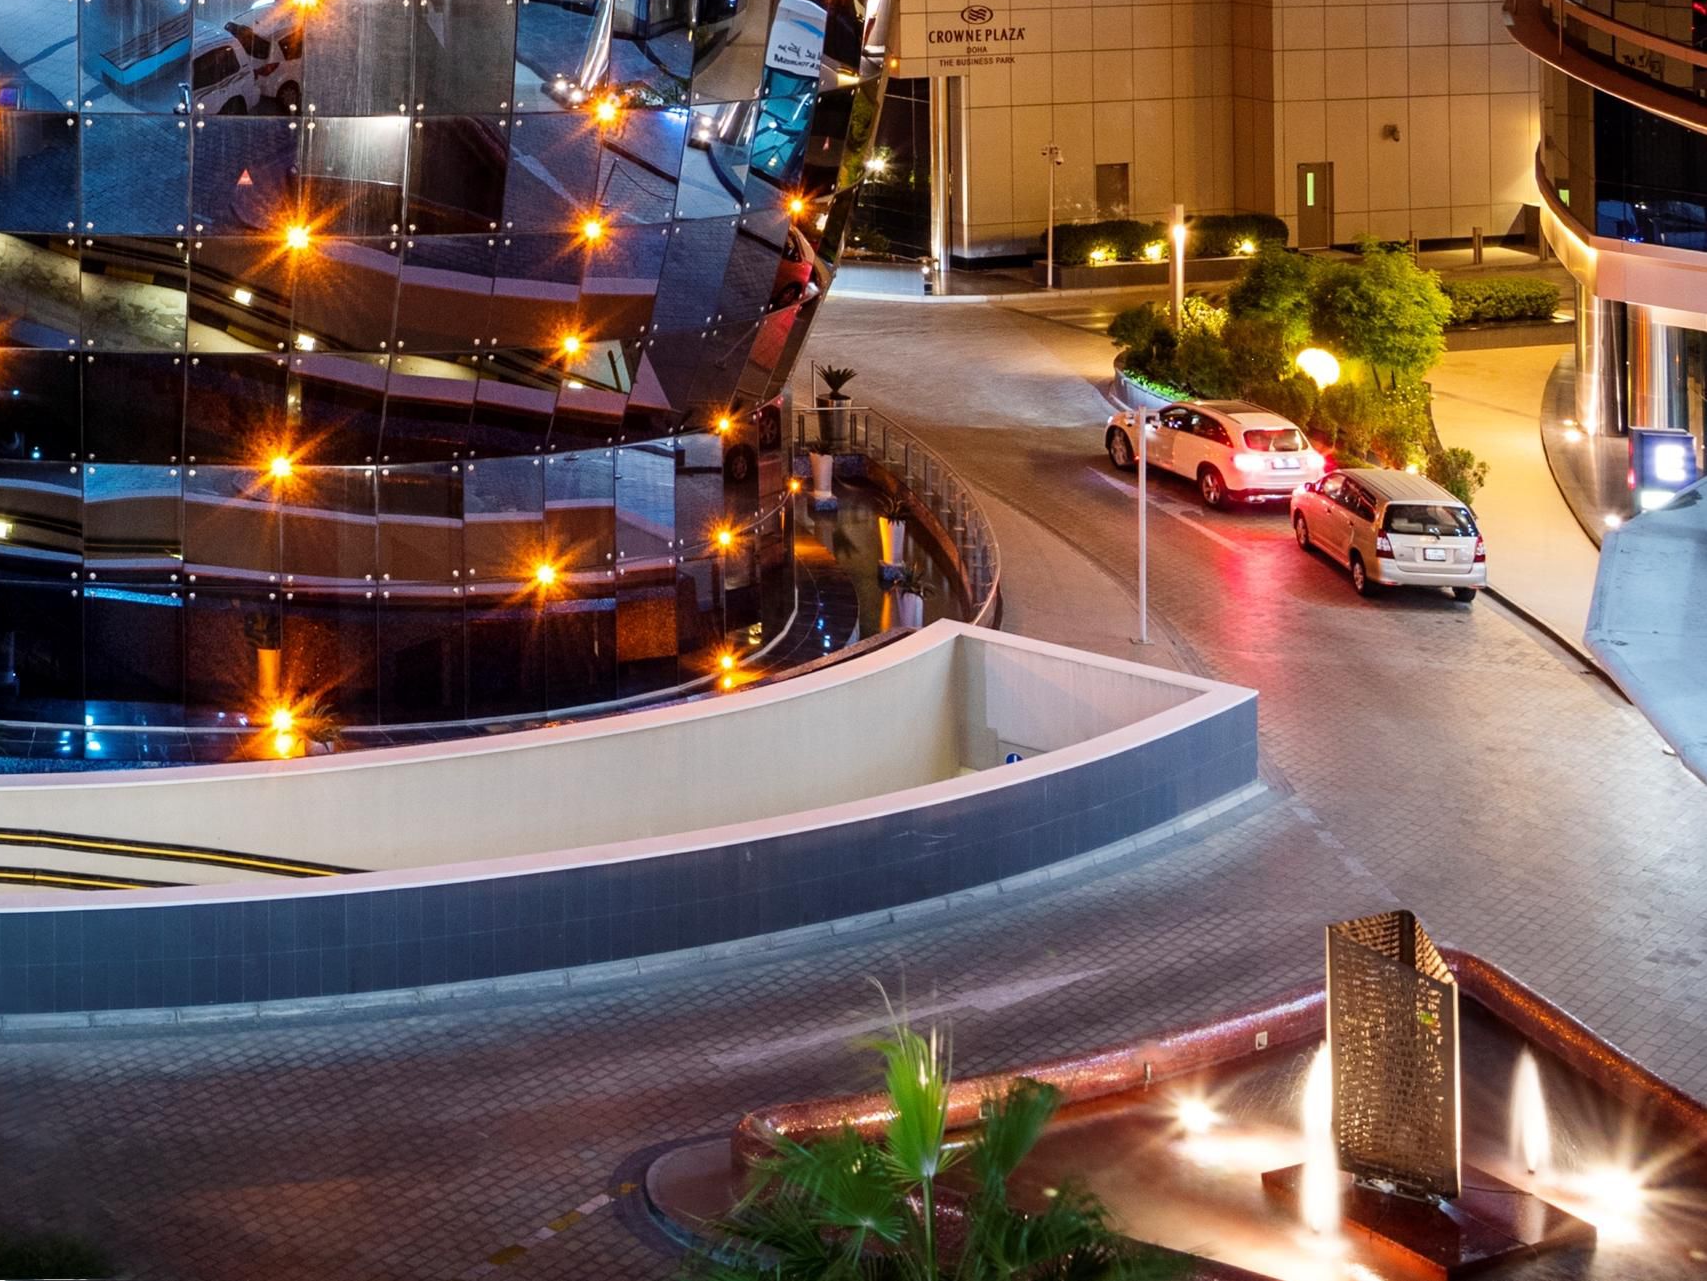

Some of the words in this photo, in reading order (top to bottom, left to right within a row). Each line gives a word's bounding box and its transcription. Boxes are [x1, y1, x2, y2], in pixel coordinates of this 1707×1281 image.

[928, 28, 982, 44] CROWNE
[966, 46, 988, 54] DOHA
[939, 59, 954, 67] THE
[956, 57, 994, 66] BUSINESS
[995, 56, 1015, 64] PARK
